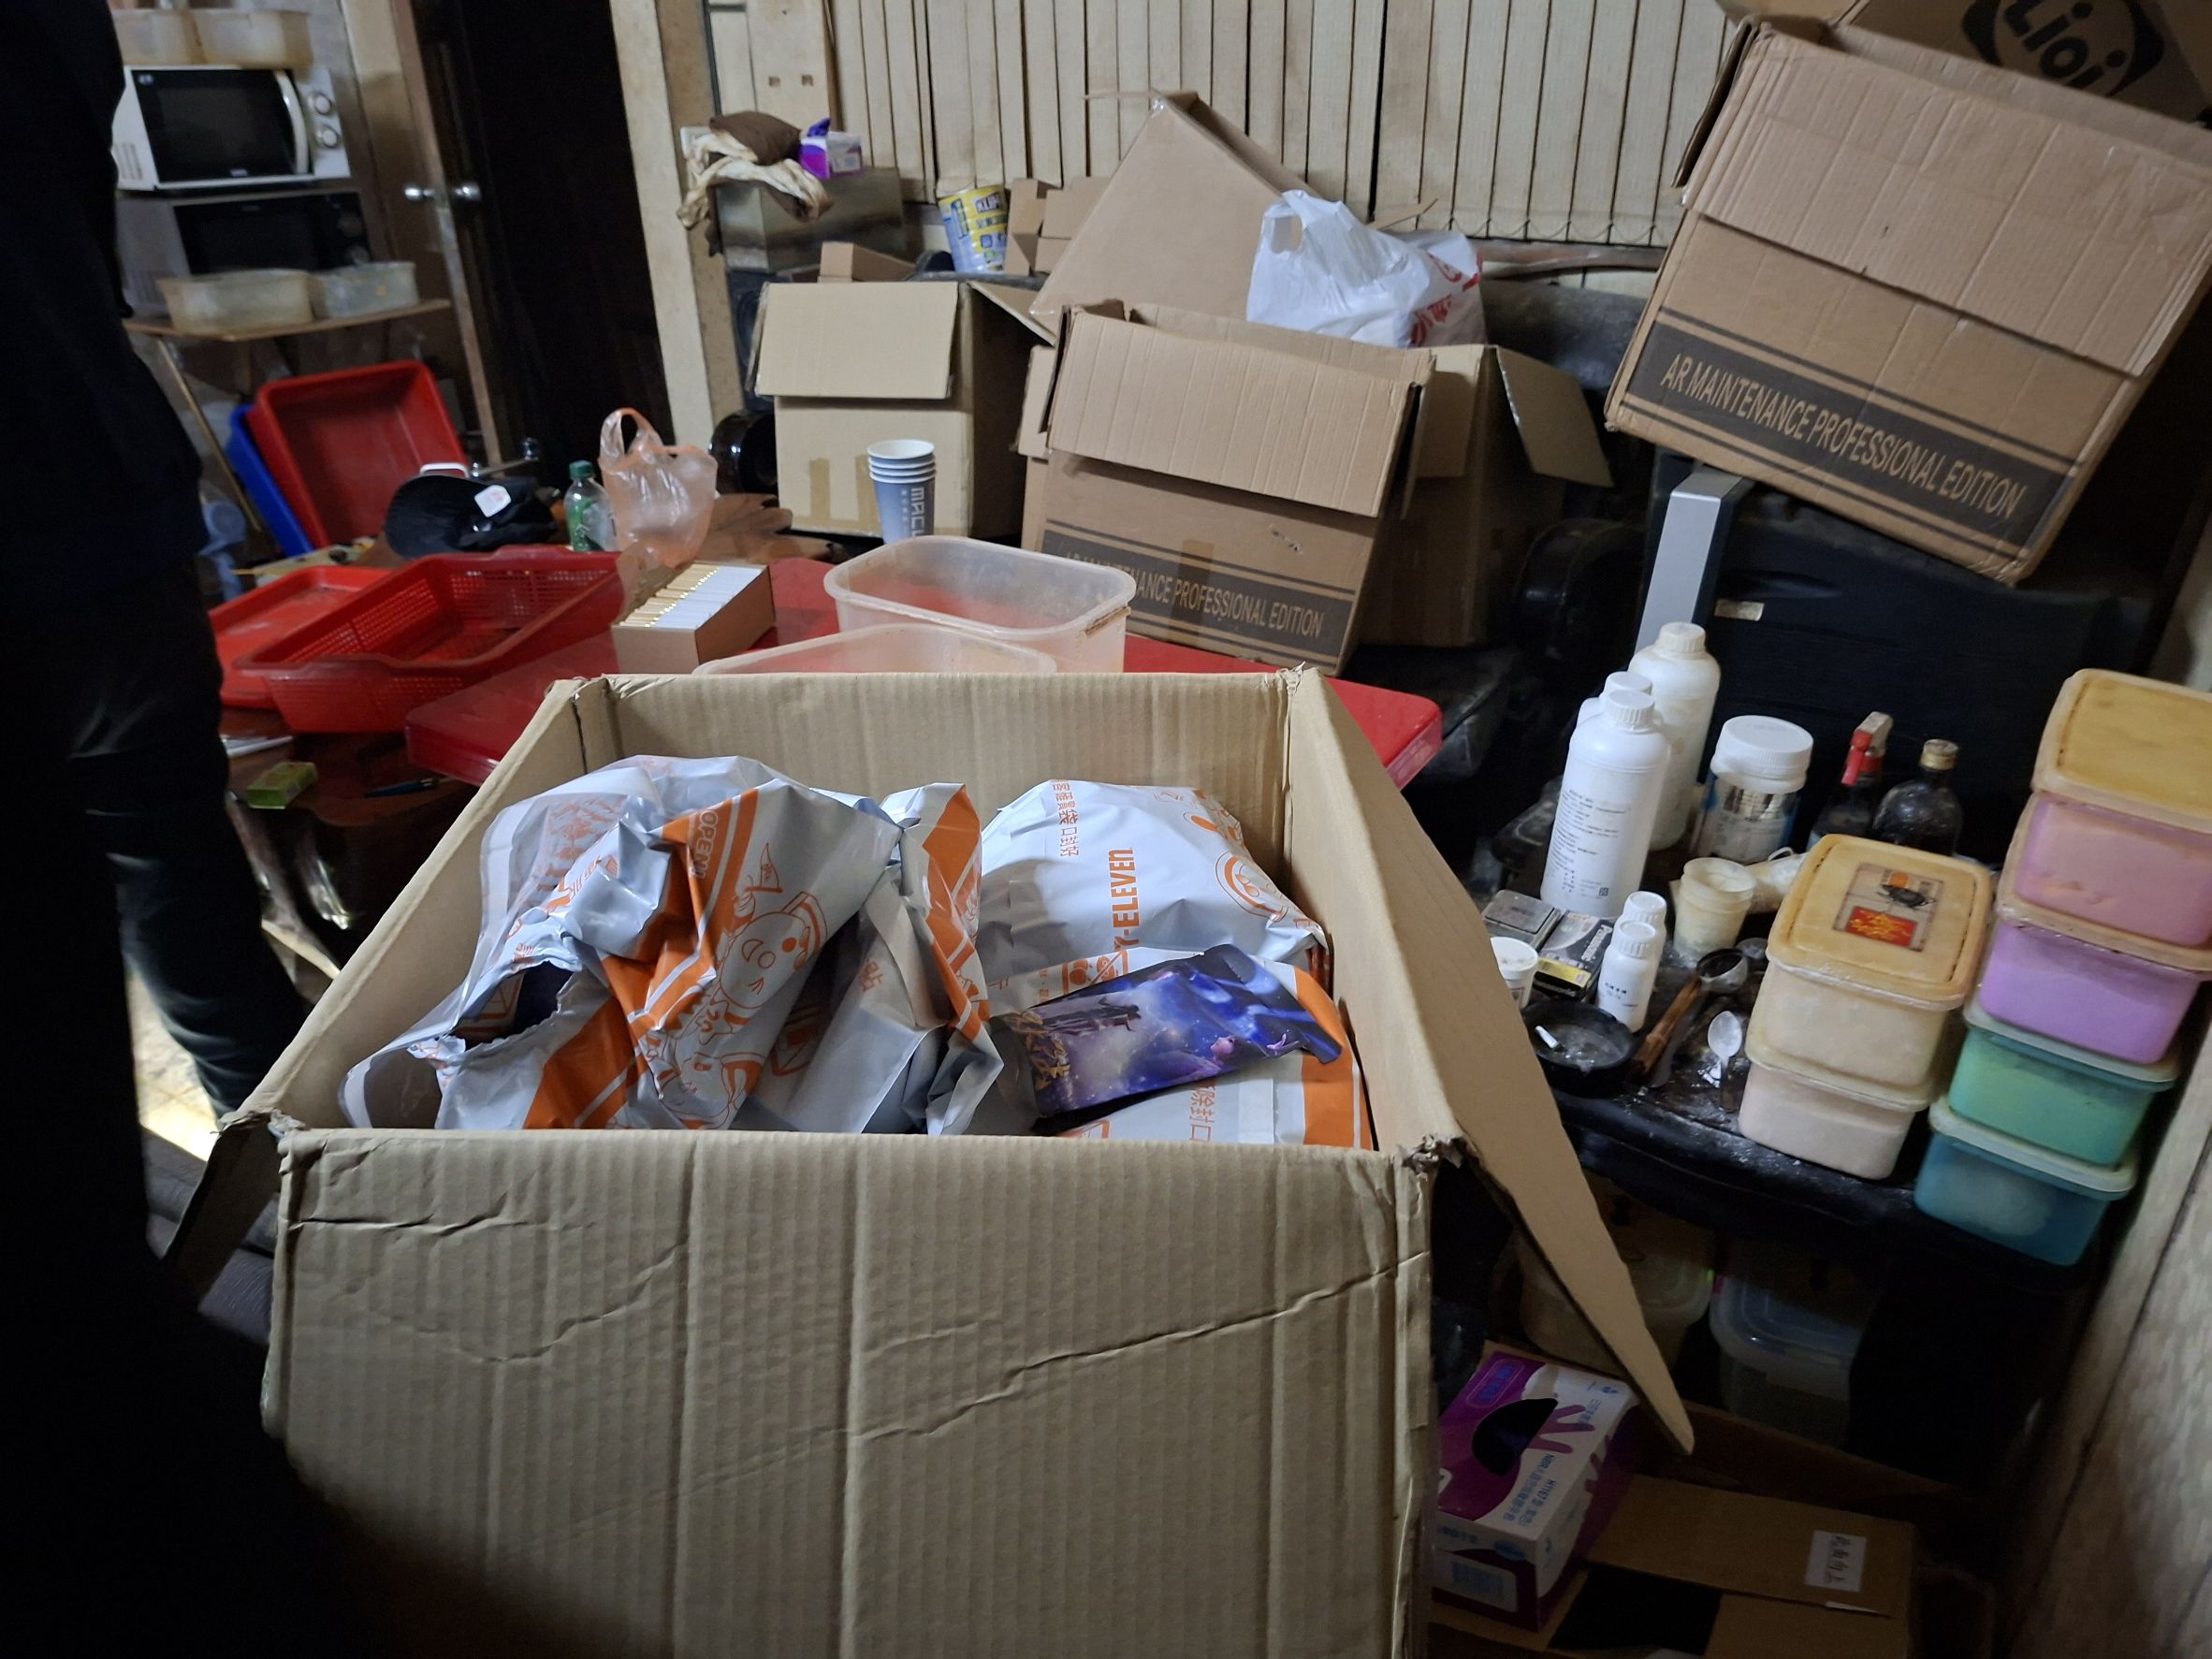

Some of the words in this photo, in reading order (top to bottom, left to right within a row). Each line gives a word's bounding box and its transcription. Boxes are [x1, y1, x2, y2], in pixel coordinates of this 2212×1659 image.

[1659, 353, 1695, 393] AR
[1684, 360, 1818, 441] MAINTENANCE
[1806, 409, 1947, 491] PROFESSIONAL
[1937, 458, 2030, 519] EDITION
[1171, 578, 1268, 627] PROFESSIONAL
[1268, 602, 1326, 638] EDITION
[1188, 1084, 1217, 1142] 除封口
